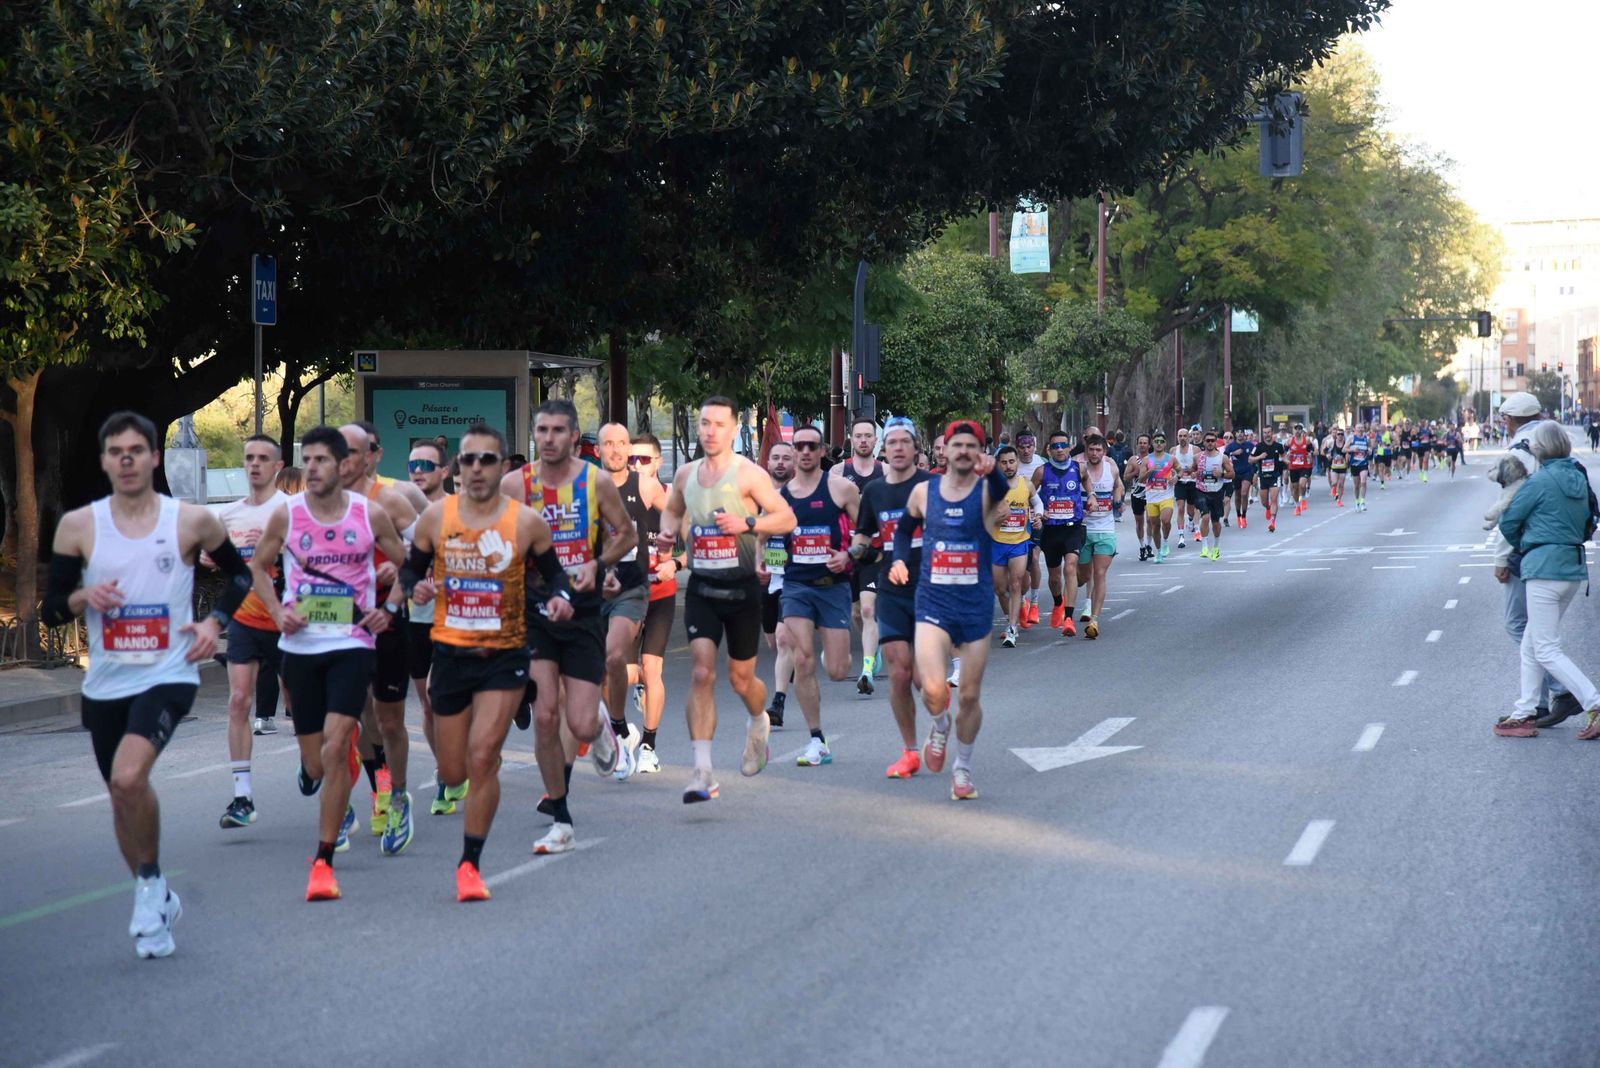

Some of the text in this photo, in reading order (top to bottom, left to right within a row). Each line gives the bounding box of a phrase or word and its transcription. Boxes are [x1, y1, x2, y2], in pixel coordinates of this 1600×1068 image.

[256, 281, 276, 300] TAXI
[422, 404, 451, 412] Pásate
[408, 415, 439, 425] Gana
[552, 531, 581, 541] ZURICH
[803, 528, 826, 536] ZURICH
[796, 546, 827, 555] FLORIAN
[947, 543, 974, 551] ZURICH
[694, 547, 737, 559] JOE KENNY
[445, 557, 486, 571] MANS
[124, 607, 163, 616] ZURICH
[448, 604, 499, 617] AS MANEL
[309, 611, 337, 621] FRAN
[114, 636, 159, 649] NANDO
